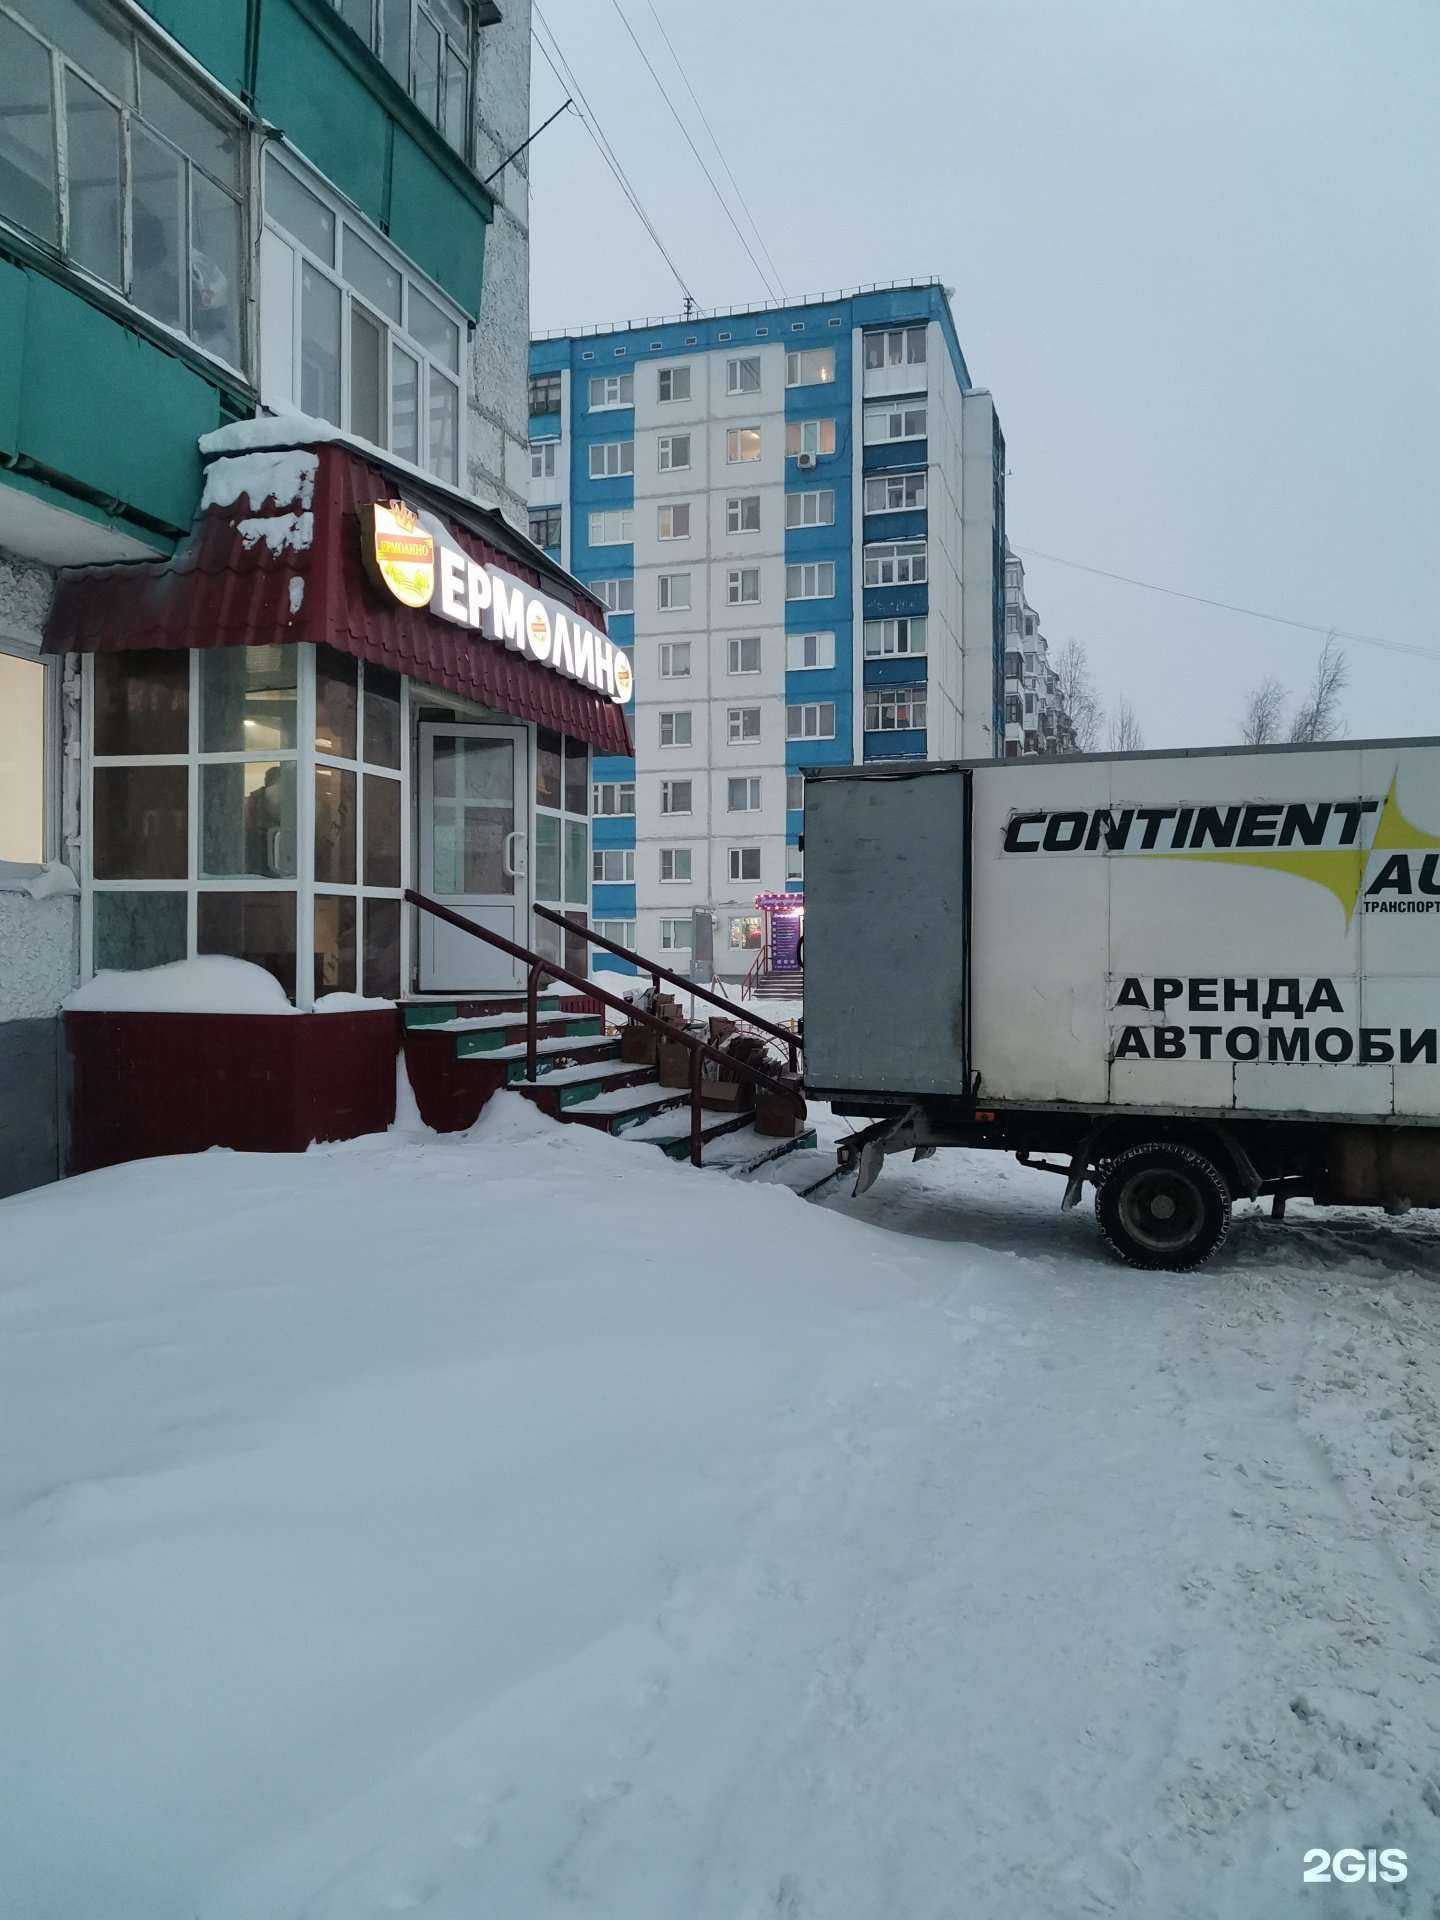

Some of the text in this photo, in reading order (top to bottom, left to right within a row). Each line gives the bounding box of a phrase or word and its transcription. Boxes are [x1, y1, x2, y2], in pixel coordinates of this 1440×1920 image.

[440, 545, 633, 704] ЕРМОЛИНО
[1002, 800, 1381, 853] CONTINENT
[1363, 901, 1440, 913] ТРАНСПОРТ
[1115, 977, 1345, 1020] АРЕНДА
[1114, 1026, 1438, 1064] АВТОМОБИ
